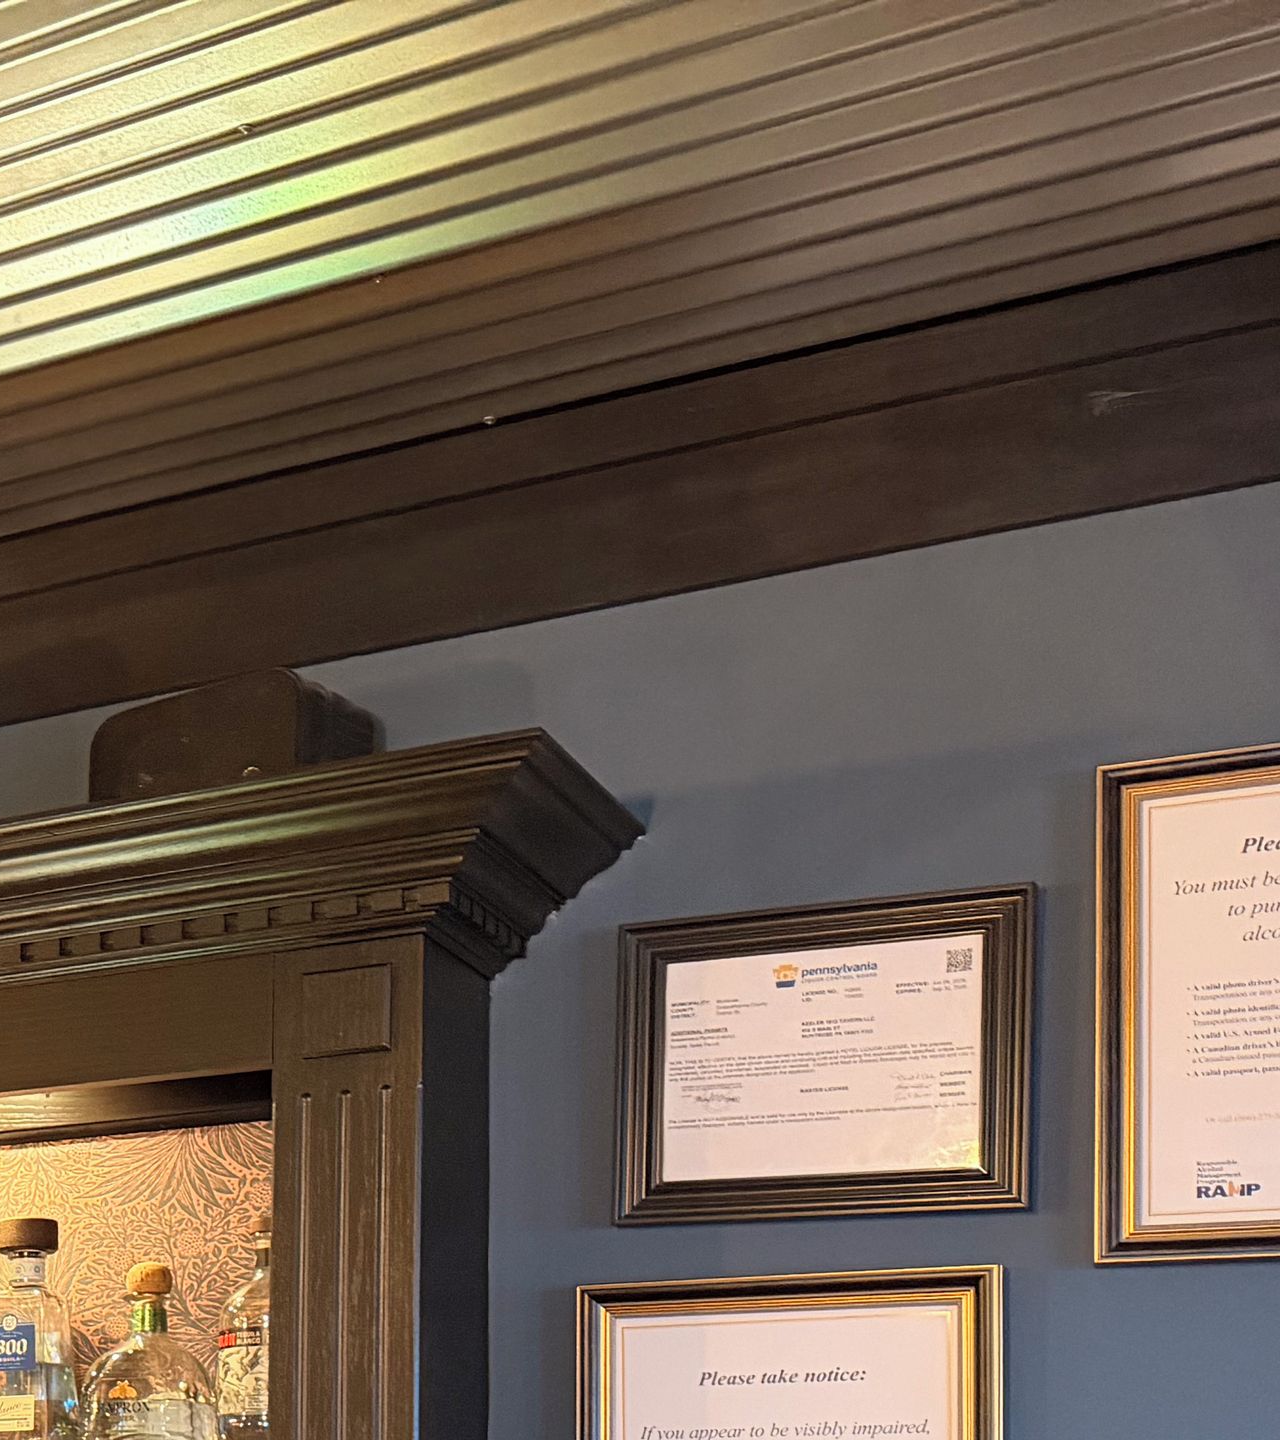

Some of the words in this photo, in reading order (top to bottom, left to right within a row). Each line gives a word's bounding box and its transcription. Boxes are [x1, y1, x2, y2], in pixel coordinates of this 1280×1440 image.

[1173, 881, 1205, 896] You
[1211, 875, 1257, 892] must
[1228, 902, 1246, 917] to
[801, 961, 878, 978] pennsylvania
[1196, 1181, 1261, 1199] RAMP
[698, 1371, 756, 1386] Please
[760, 1369, 799, 1384] take
[804, 1366, 867, 1382] notice:
[749, 1425, 765, 1437] to
[770, 1422, 789, 1437] be
[794, 1420, 847, 1439] visibly
[852, 1418, 931, 1439] impaired,
